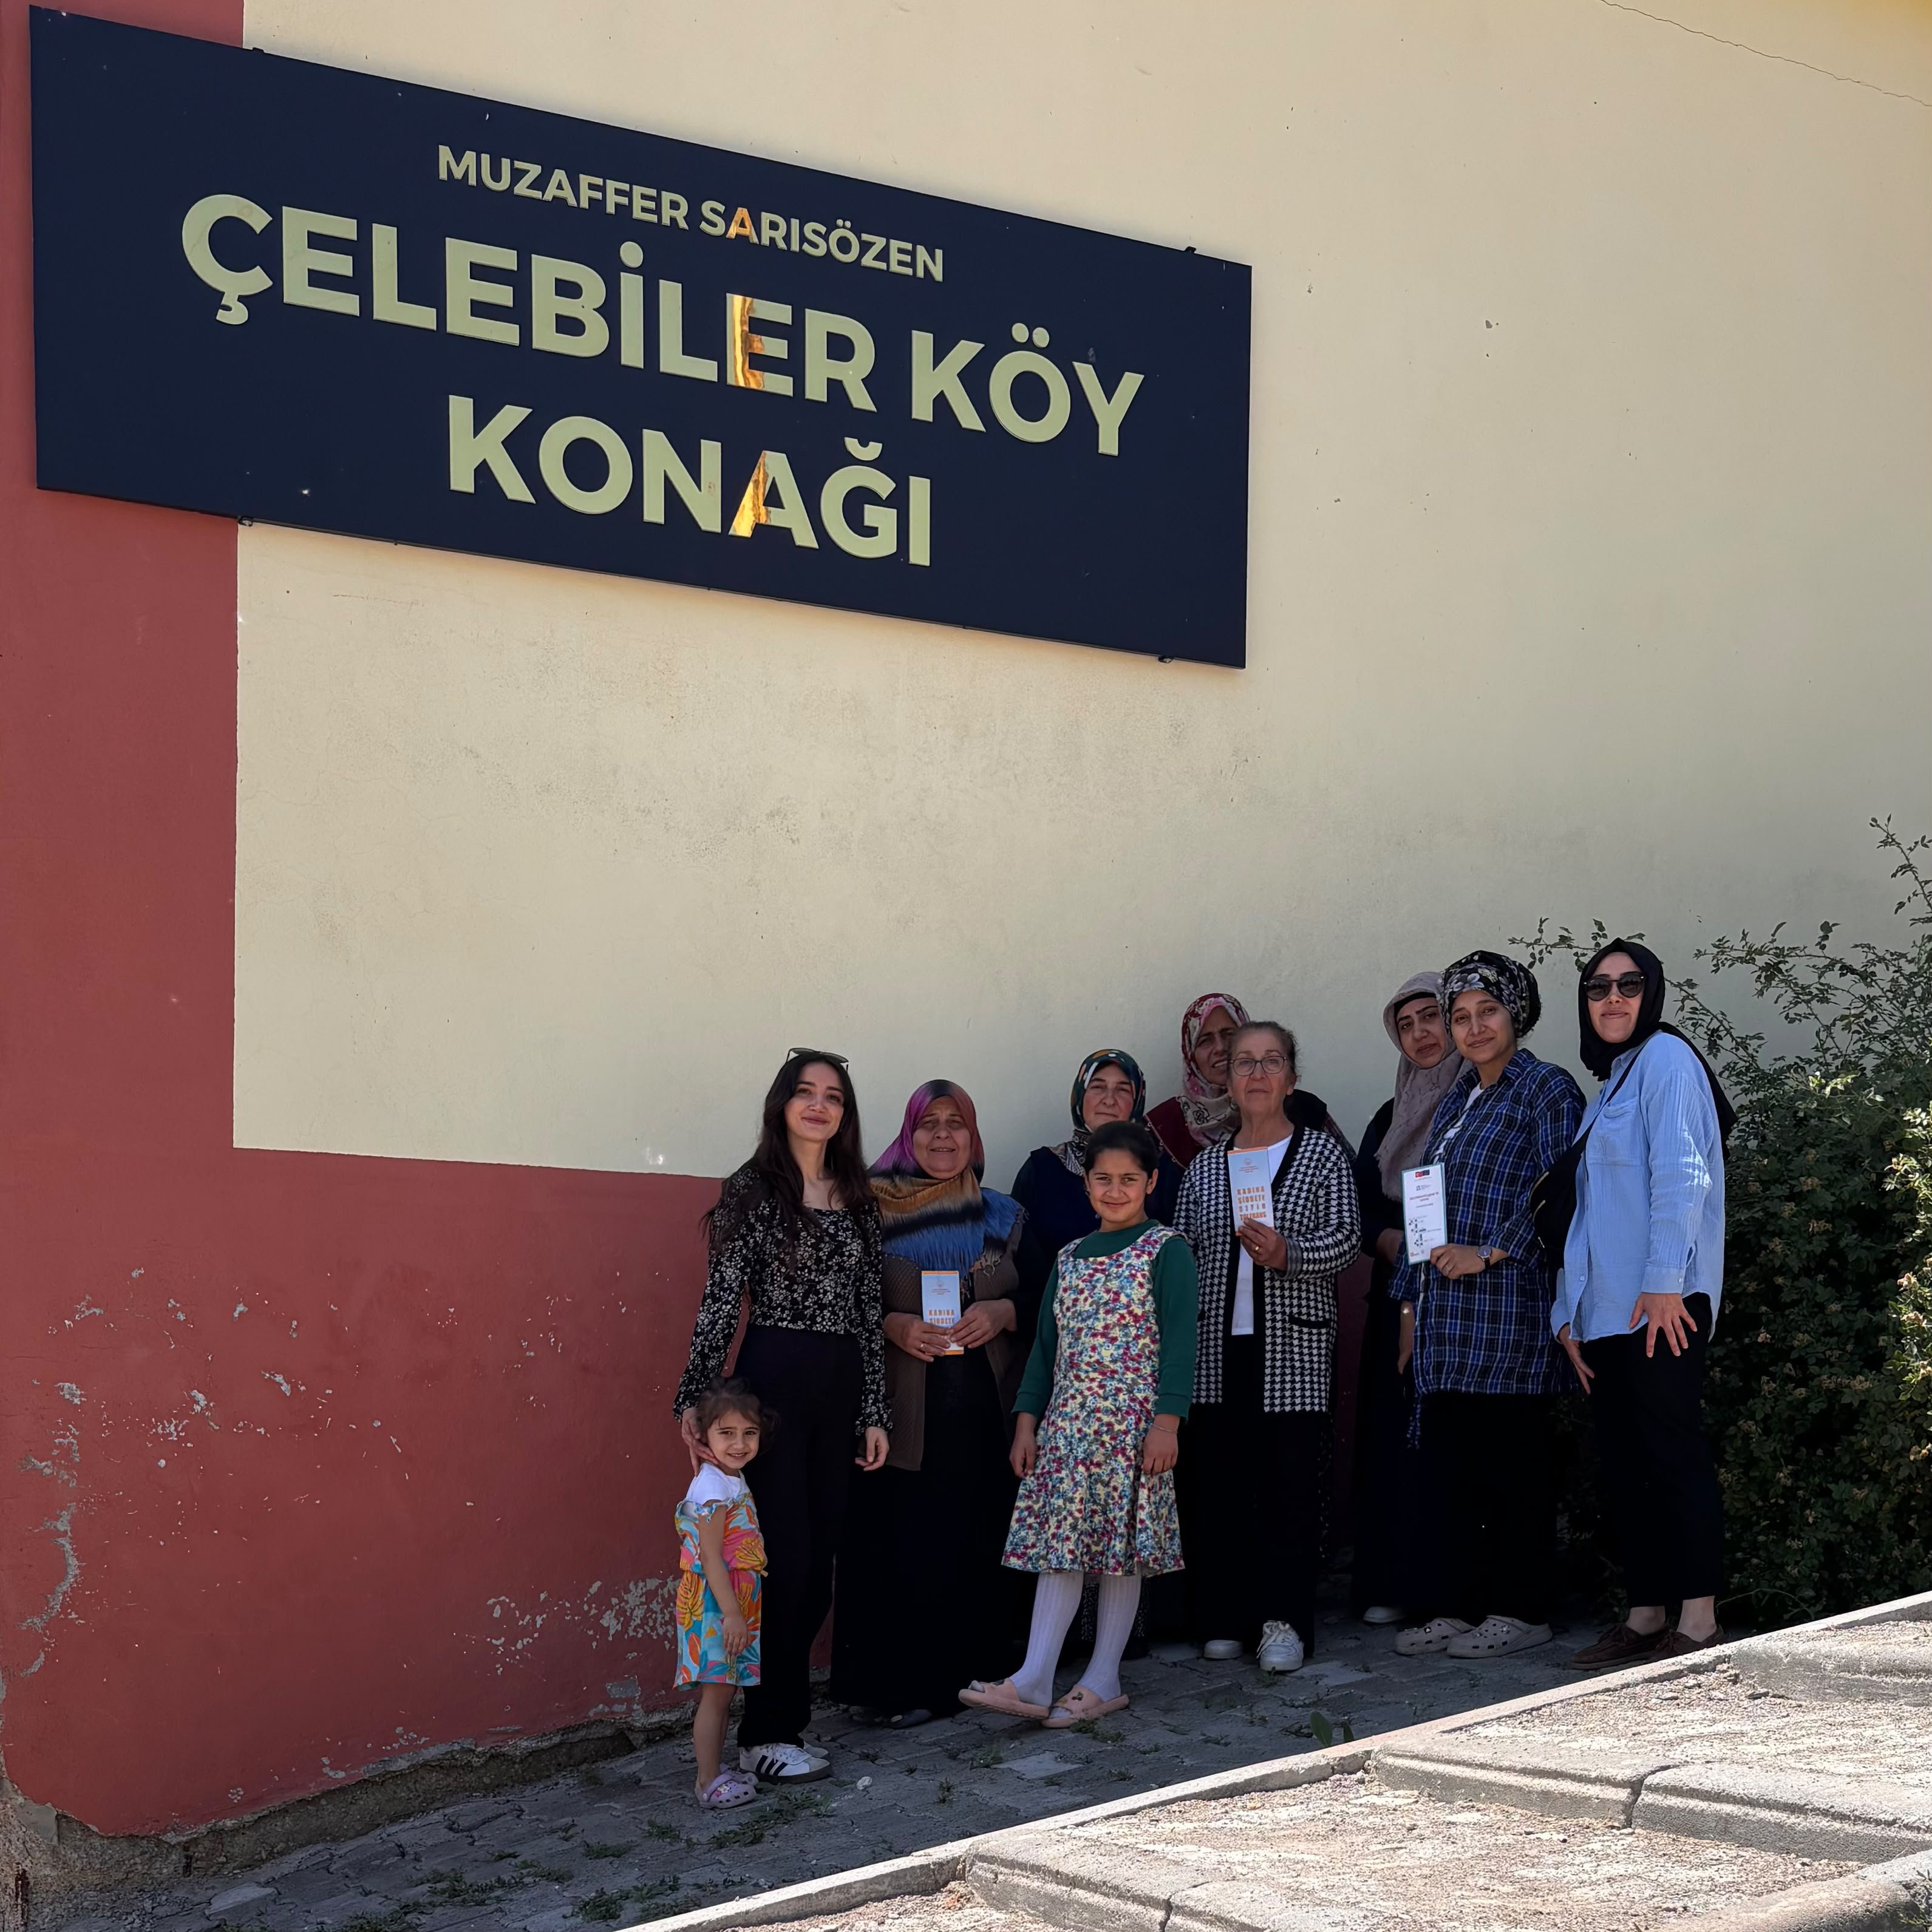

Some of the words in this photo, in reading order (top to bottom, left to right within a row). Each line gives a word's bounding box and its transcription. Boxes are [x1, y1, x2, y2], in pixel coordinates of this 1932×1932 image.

[438, 144, 689, 231] MUZAFFER
[699, 200, 944, 283] SARISÖZEN
[182, 193, 878, 413] ÇELEBİLER
[911, 322, 1146, 457] KÖY
[448, 393, 931, 567] KONAĞI
